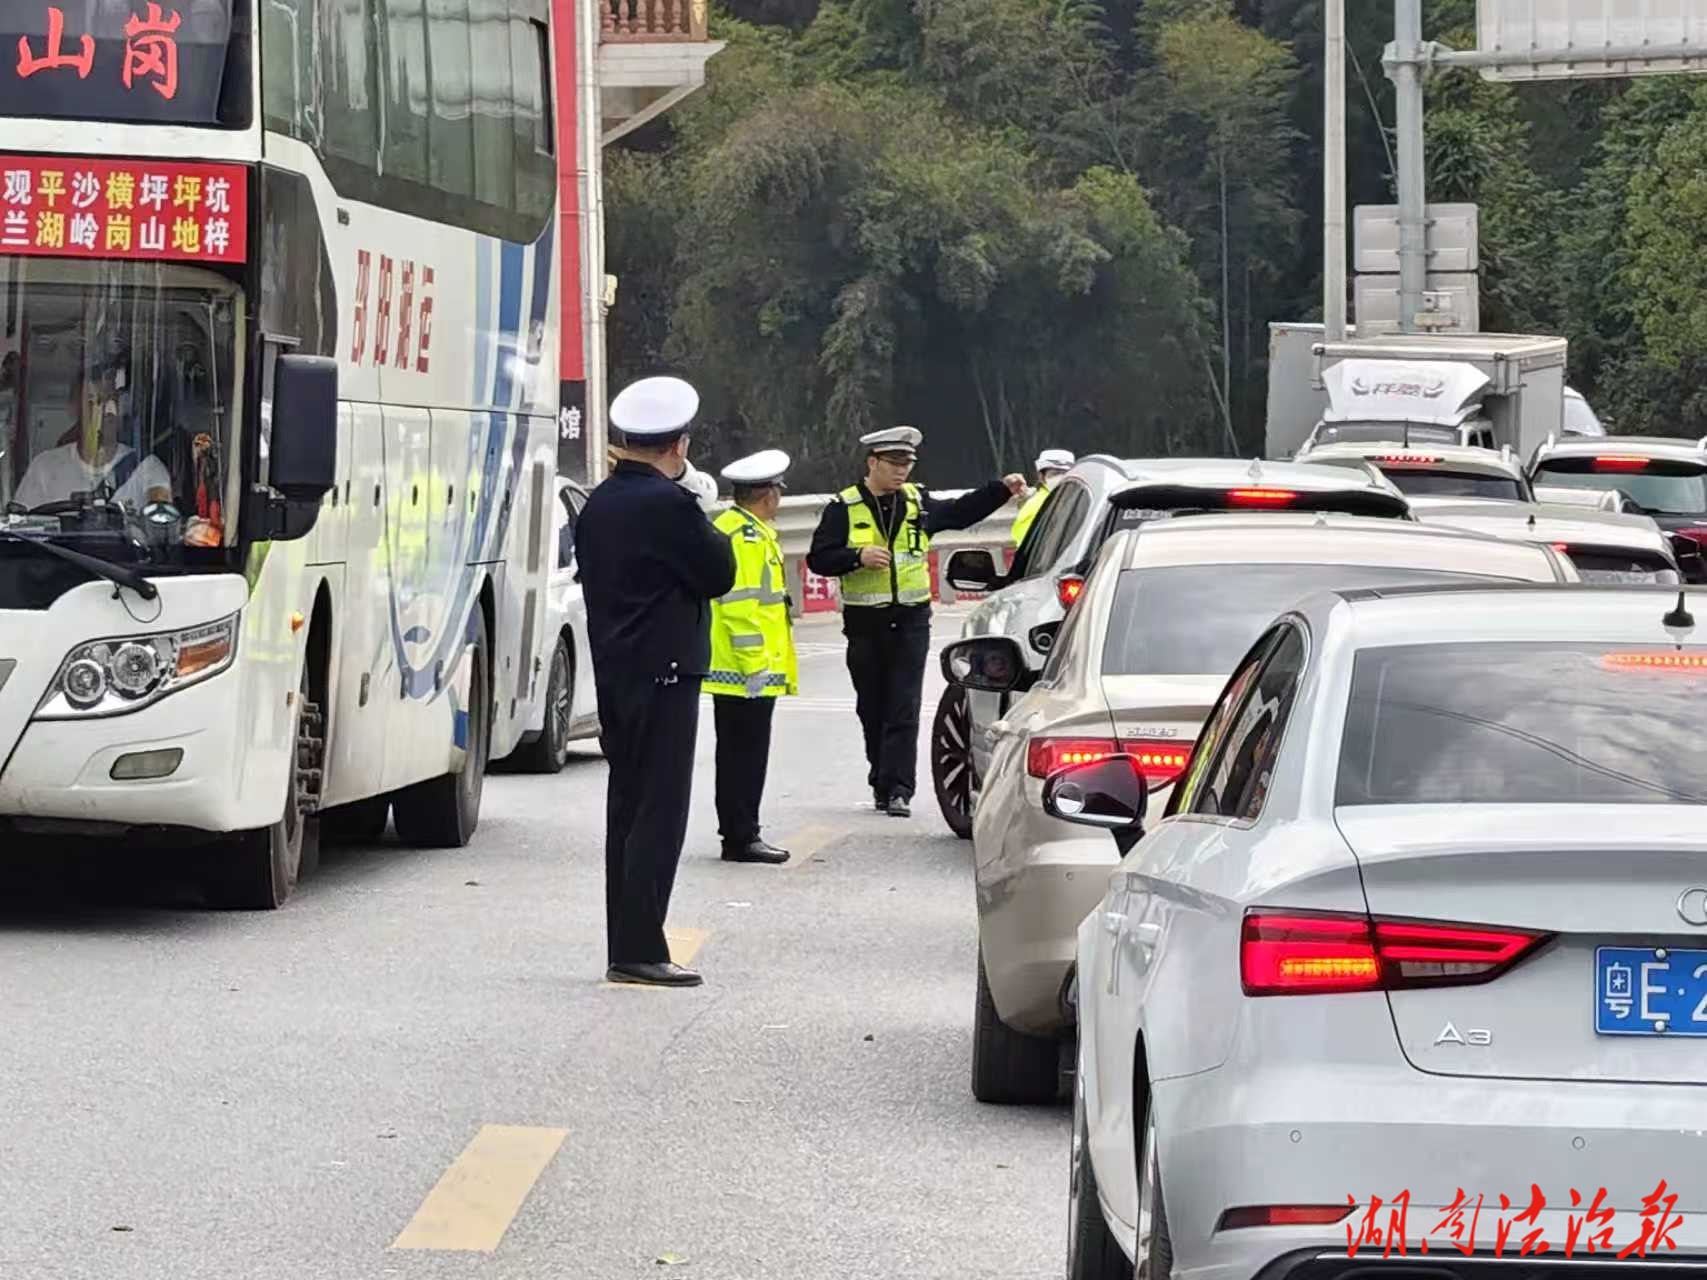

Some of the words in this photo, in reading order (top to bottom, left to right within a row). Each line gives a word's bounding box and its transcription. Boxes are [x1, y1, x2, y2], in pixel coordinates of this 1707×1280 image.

[15, 2, 182, 100] 山岗
[559, 405, 582, 439] 馆
[1433, 1021, 1493, 1047] A3
